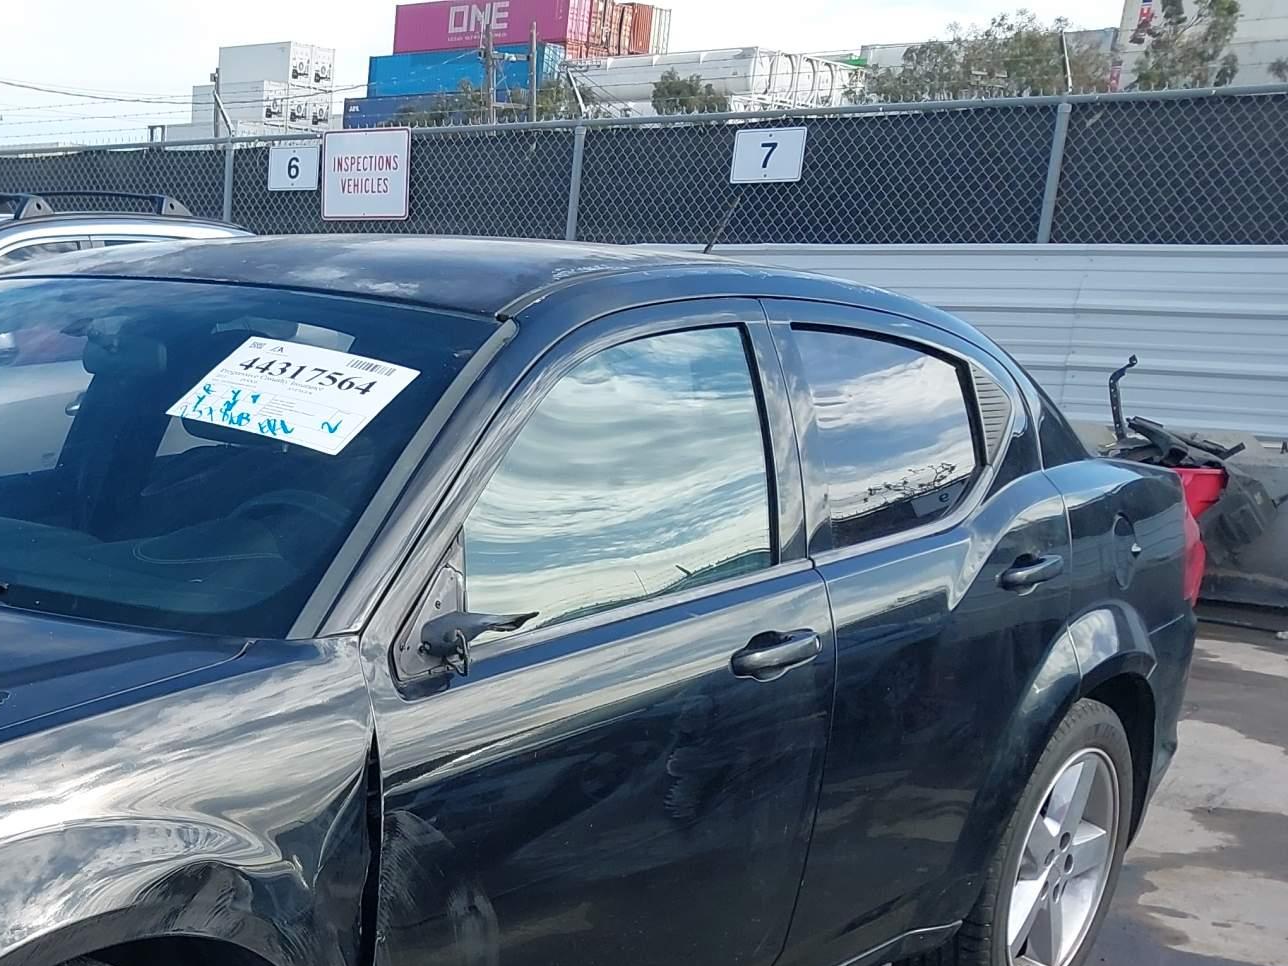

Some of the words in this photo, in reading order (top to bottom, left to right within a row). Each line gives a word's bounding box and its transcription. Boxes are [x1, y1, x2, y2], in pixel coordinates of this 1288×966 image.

[448, 1, 510, 34] ONE
[333, 155, 399, 173] INSPECTIONS
[761, 142, 778, 169] 7
[287, 157, 300, 179] 6
[341, 177, 389, 194] VEHICLES
[239, 357, 378, 395] 44317564
